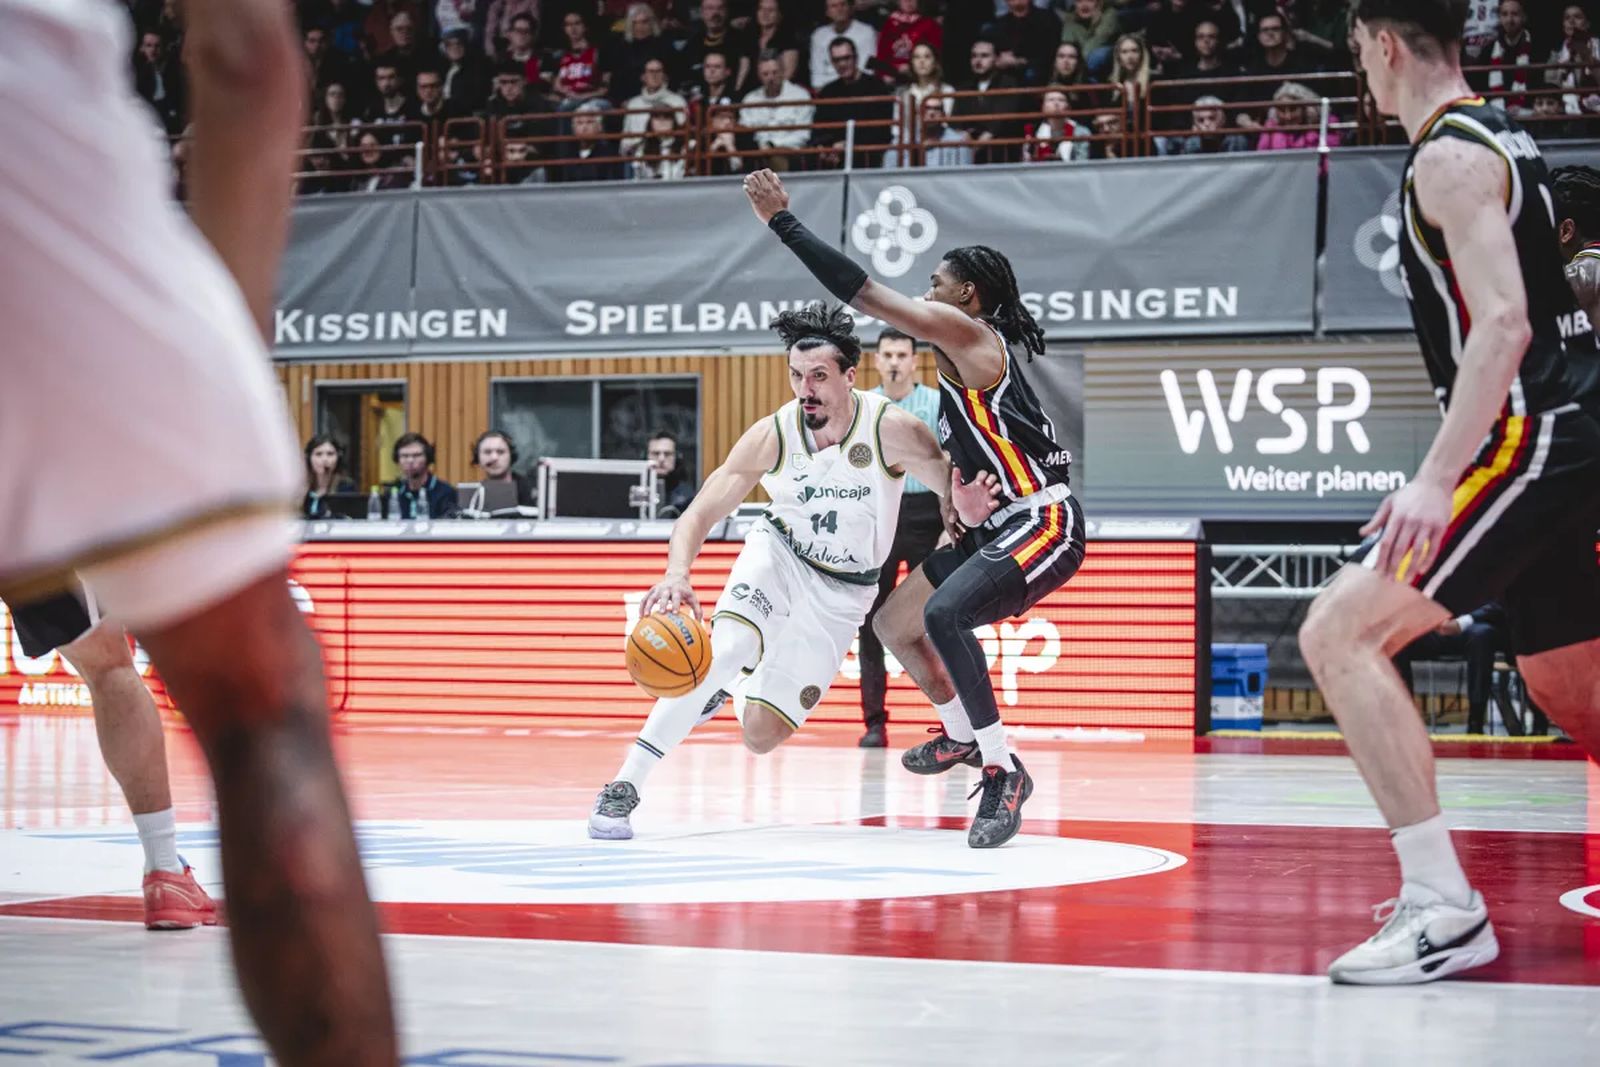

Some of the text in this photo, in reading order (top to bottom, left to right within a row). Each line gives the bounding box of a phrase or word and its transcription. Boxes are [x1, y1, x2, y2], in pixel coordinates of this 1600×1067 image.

[1018, 286, 1239, 322] SSINGEN
[274, 308, 508, 343] KISSINGEN
[1160, 367, 1372, 454] WSR
[814, 484, 871, 501] Unicaja
[1224, 465, 1312, 491] Weiter
[810, 510, 838, 535] 14
